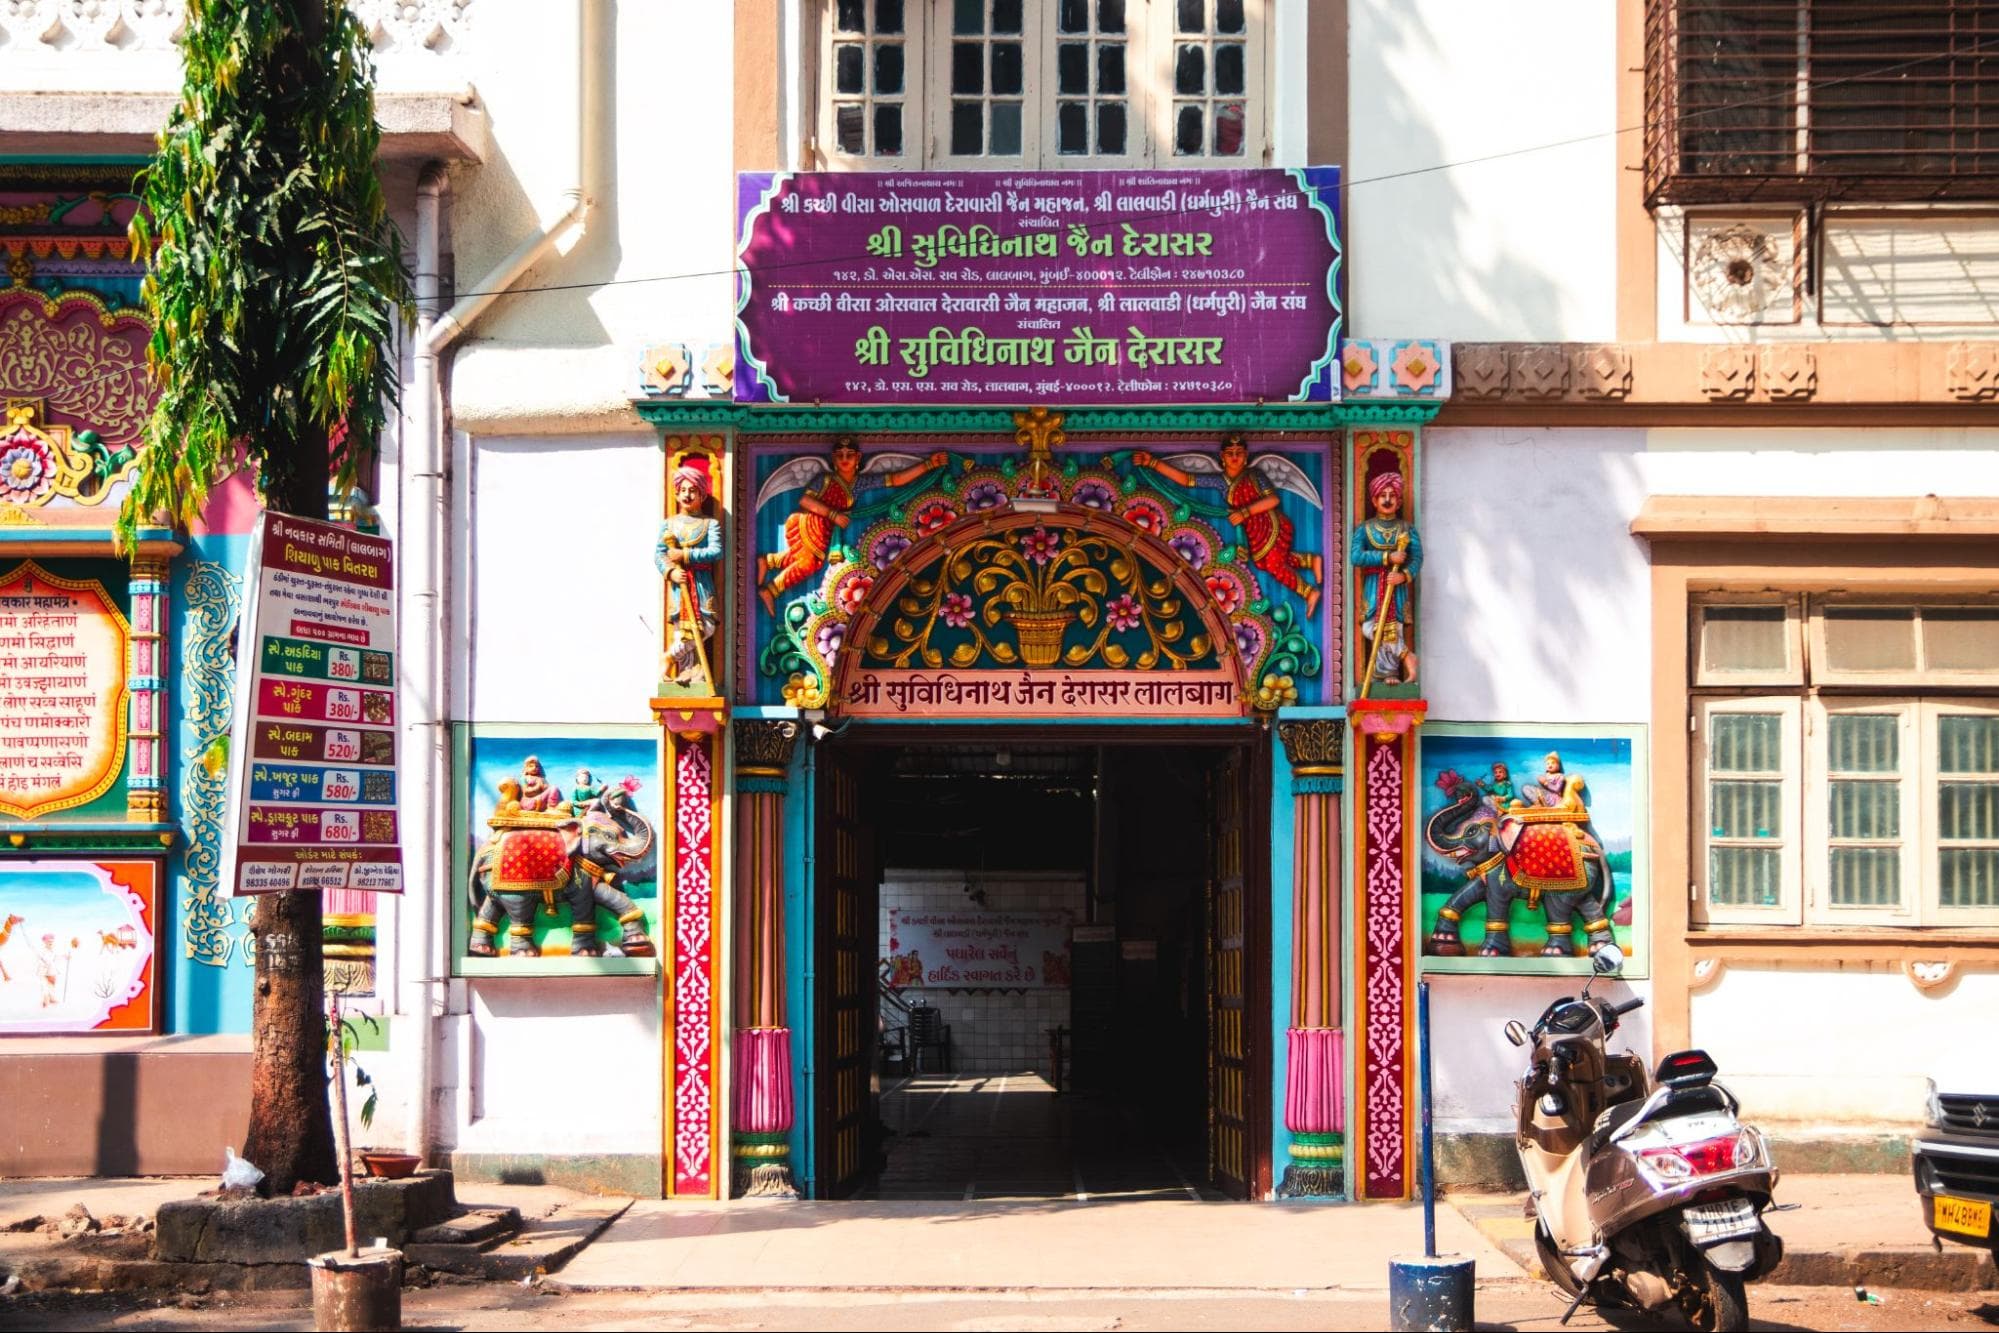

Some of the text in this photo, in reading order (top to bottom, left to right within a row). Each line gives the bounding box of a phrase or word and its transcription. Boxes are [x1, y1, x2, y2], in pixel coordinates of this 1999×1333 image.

[781, 192, 799, 213] શ્રી
[804, 192, 836, 213] કચ્છી
[842, 192, 874, 213] વીસા
[879, 192, 940, 213] ઓસવાળ
[945, 191, 1002, 213] દેરાવાસી
[1007, 191, 1029, 212] જૈન
[1035, 196, 1089, 214] મહાજન,
[1094, 191, 1112, 212] શ્રી
[1117, 190, 1176, 212] લાલવાડી
[1181, 189, 1241, 217] (ધર્મપુરી)
[1246, 189, 1269, 212] જૈન
[1018, 215, 1060, 228] સંચાલિત
[867, 224, 1213, 267] શ્રી સુવિધિનાથ જૈન દેરાસર
[940, 271, 957, 281] રાવ
[961, 267, 983, 282] રોડ,
[986, 271, 1037, 281] લાલબાગ,
[1129, 266, 1171, 280] ટેલીફોન
[771, 291, 1307, 316] श्री कच्छी वीसा ओसवाल देरावासी जैन महाजन, श्री लालवाडी (धर्मपुरी) जैन संघ
[1016, 317, 1061, 330] संचालित
[854, 326, 1223, 378] श्री सुविधिनाथ जैन देरासर
[272, 520, 283, 536] શ્રી
[285, 528, 316, 545] નવકાર
[317, 533, 345, 550] સમિતી
[285, 544, 378, 578] શિયાળુ પાક વિતરણ
[0, 593, 70, 610] वकार महामंत्र
[0, 612, 78, 630] मो अरिहंताणं
[0, 652, 88, 669] मो आयरियाणं
[339, 652, 350, 662] Rs.
[285, 662, 304, 673] પાક
[331, 662, 358, 678] 380/-
[338, 691, 350, 702] Rs.
[848, 673, 882, 705] श्री
[885, 673, 1012, 712] सुविधिनाथ
[1014, 671, 1057, 706] जैन
[1134, 680, 1234, 705] लालबाग
[59, 692, 97, 713] साहूणं
[283, 702, 302, 714] પાક
[329, 703, 358, 718] 380/-
[338, 732, 350, 742] Rs.
[280, 745, 300, 757] પાક
[328, 744, 358, 757] 520/-
[27, 756, 38, 768] च
[31, 773, 62, 789] मंगलं
[301, 773, 319, 784] પાક
[336, 773, 349, 784] Rs.
[326, 785, 357, 798] 580/-
[301, 814, 319, 824] પાક
[334, 814, 348, 823] Rs.
[325, 826, 357, 840] 680/-
[321, 848, 337, 859] માટે
